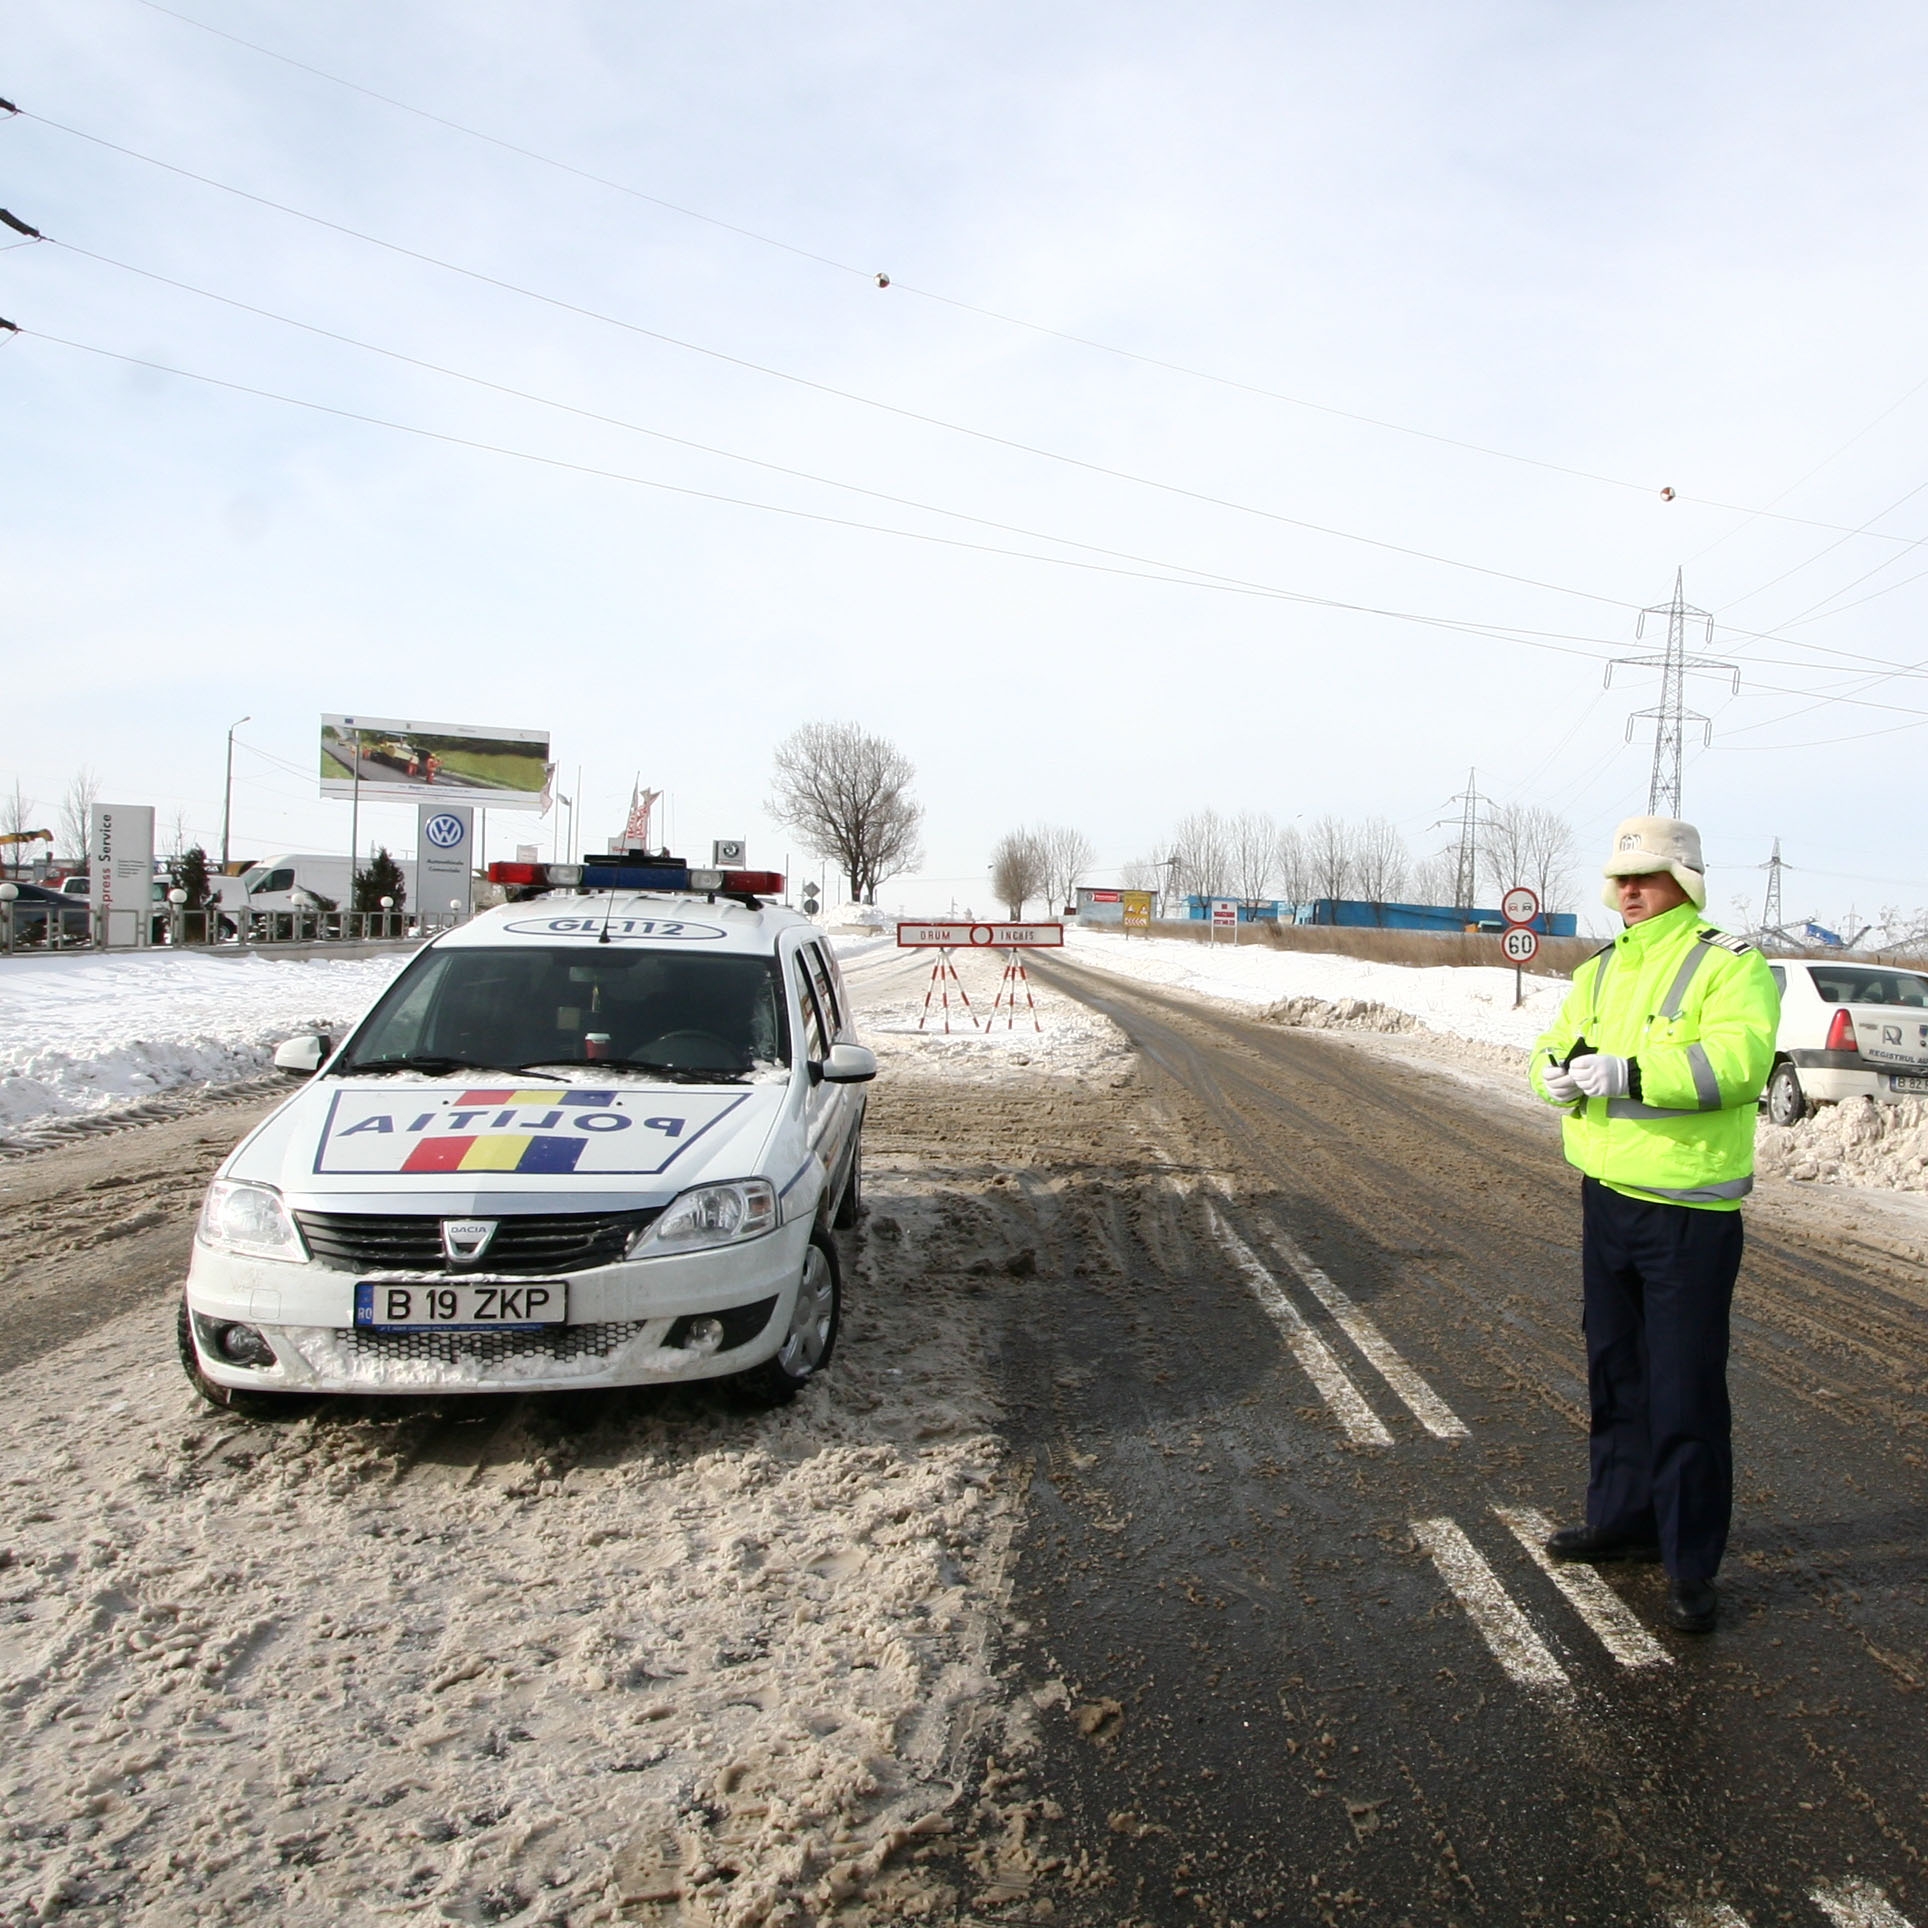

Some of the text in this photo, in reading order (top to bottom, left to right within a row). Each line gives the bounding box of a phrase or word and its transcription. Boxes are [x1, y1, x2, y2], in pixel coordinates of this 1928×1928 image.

[98, 814, 112, 862] Service
[549, 919, 684, 936] GL-112
[920, 930, 950, 941] DRUM
[1508, 935, 1532, 954] 60
[1869, 1049, 1915, 1062] REGISTRUL
[1898, 1076, 1906, 1088] B
[386, 1289, 550, 1319] B 19 ZKP
[358, 1307, 373, 1320] RO
